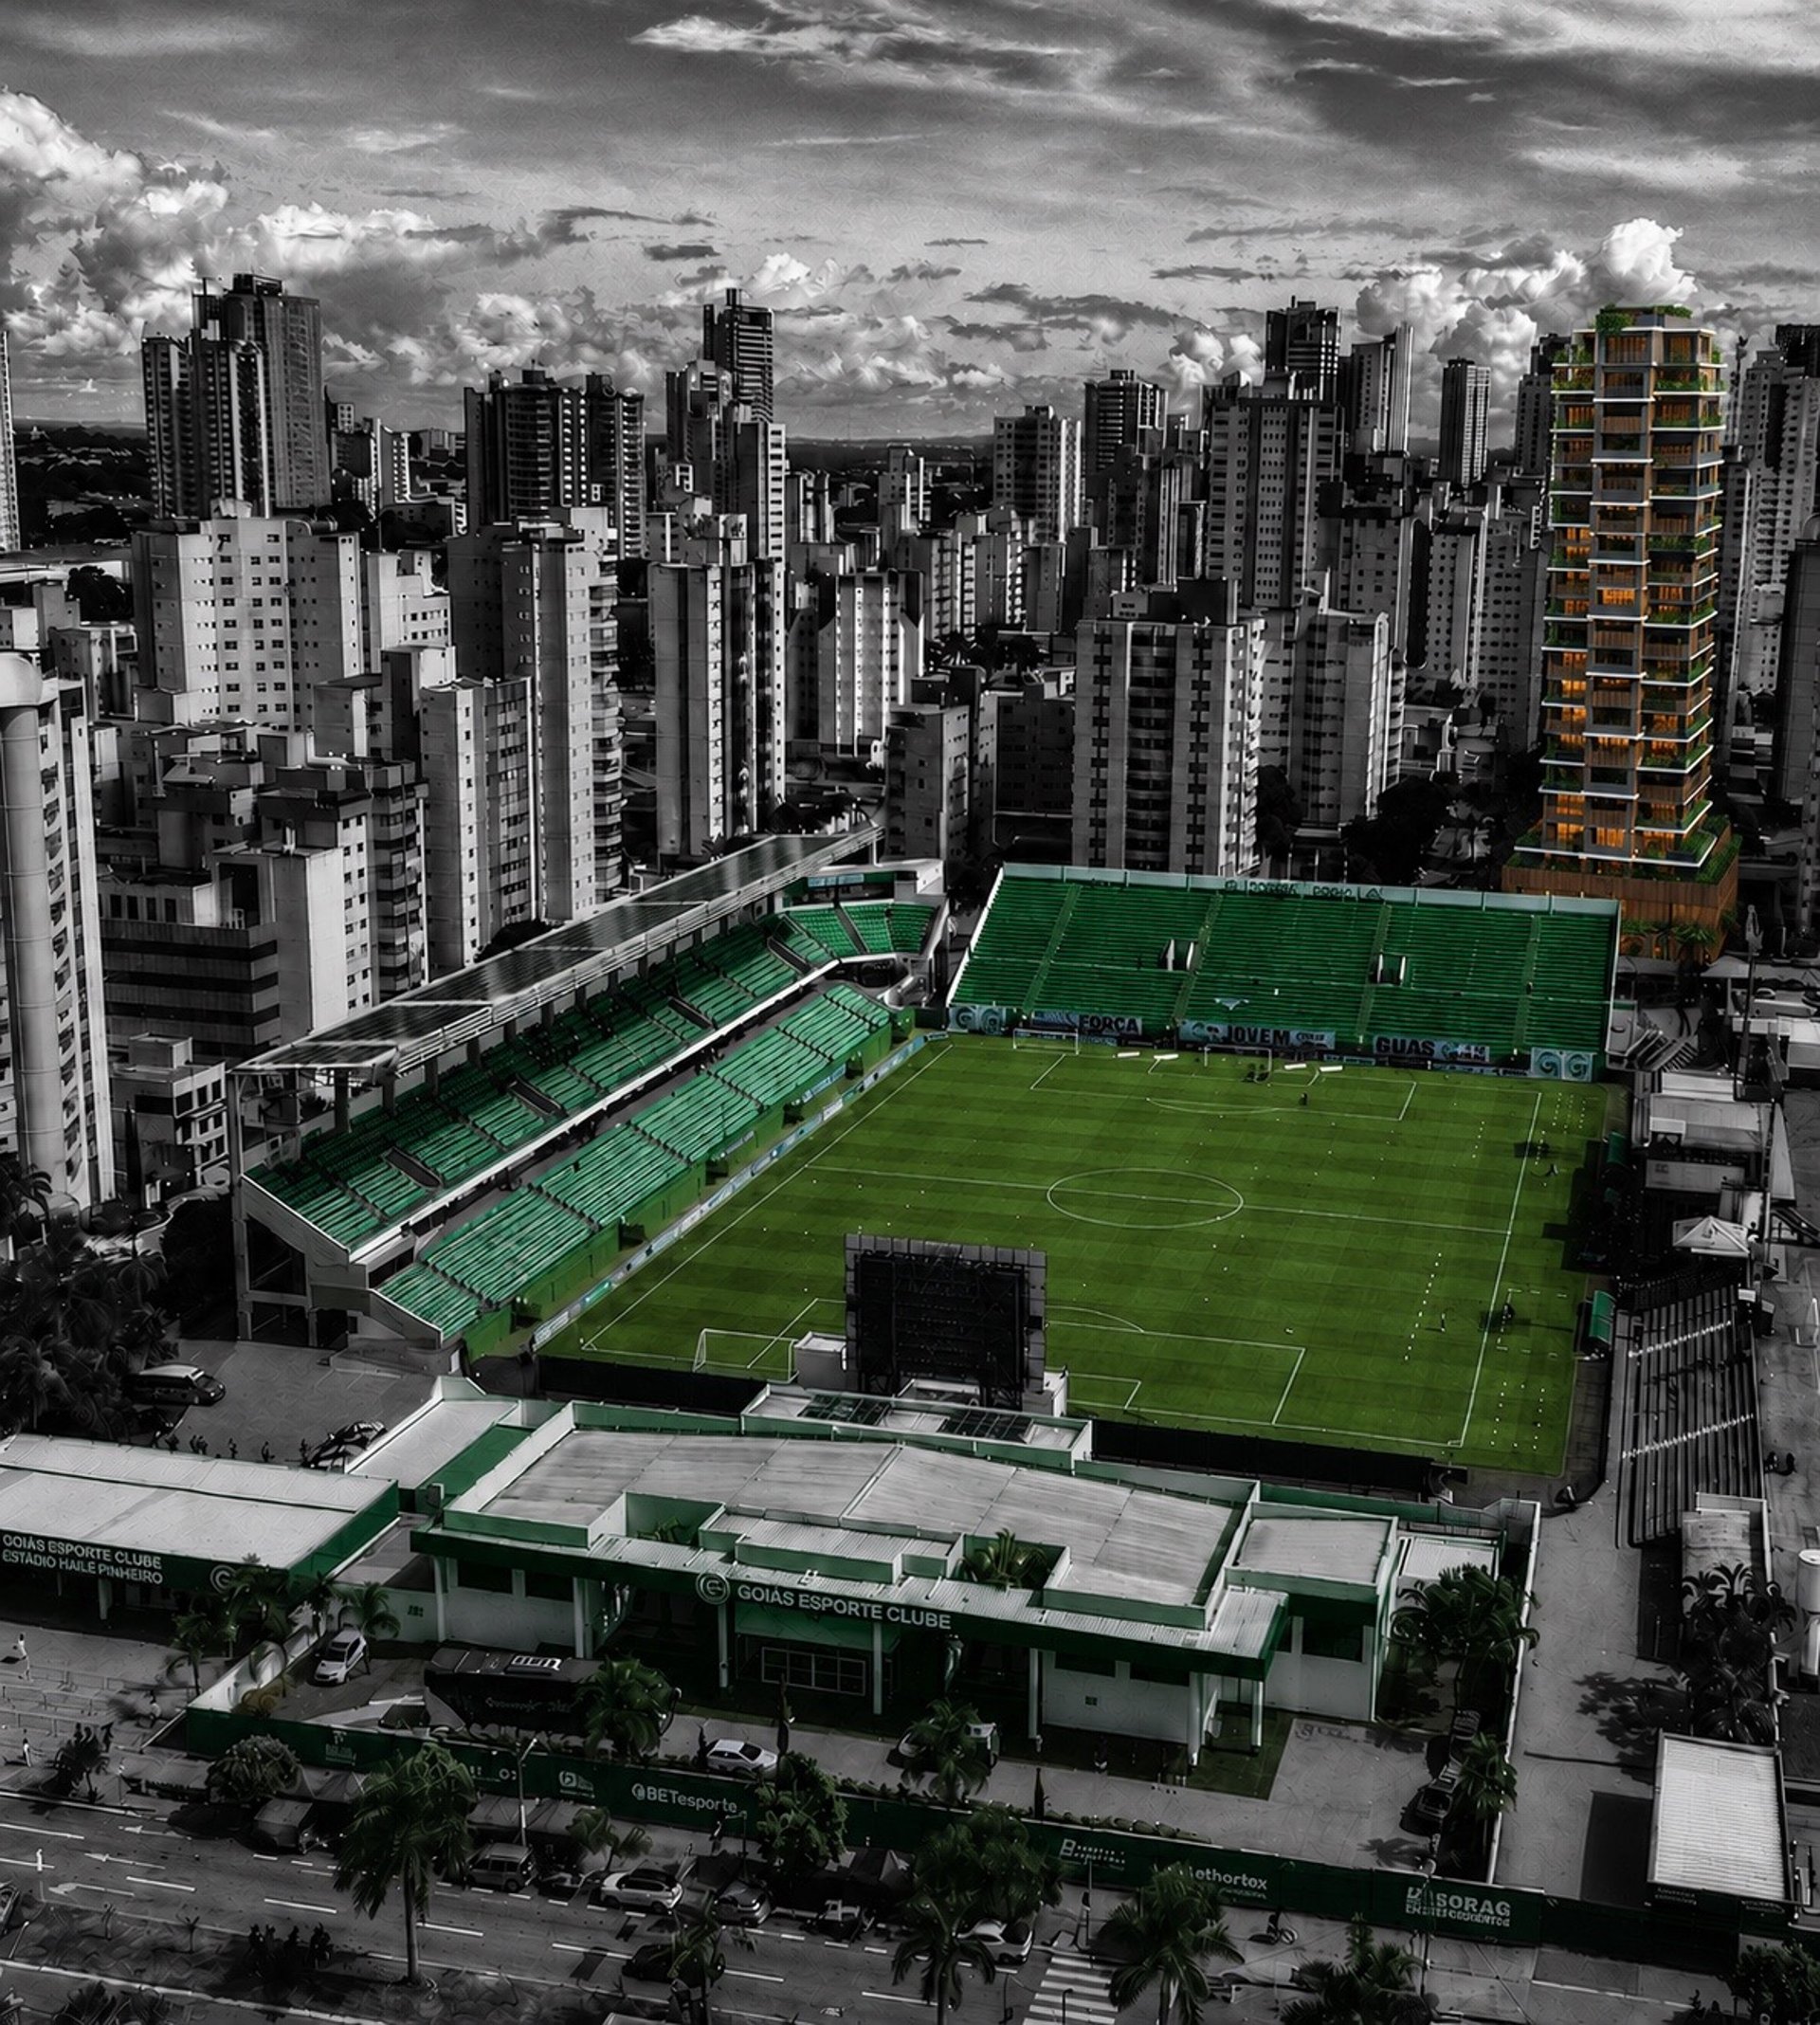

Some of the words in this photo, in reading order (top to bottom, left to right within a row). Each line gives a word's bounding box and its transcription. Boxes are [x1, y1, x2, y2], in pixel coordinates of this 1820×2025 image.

[2, 1534, 46, 1553] GOIÁS
[47, 1541, 112, 1561] ESPORTE
[114, 1551, 162, 1570] CLUBE
[59, 1558, 97, 1575] HAILE
[98, 1564, 164, 1585] PINHEIRO
[737, 1584, 794, 1607] GOIÁS
[798, 1594, 883, 1619] ESPORTE
[886, 1606, 952, 1630] CLUBE
